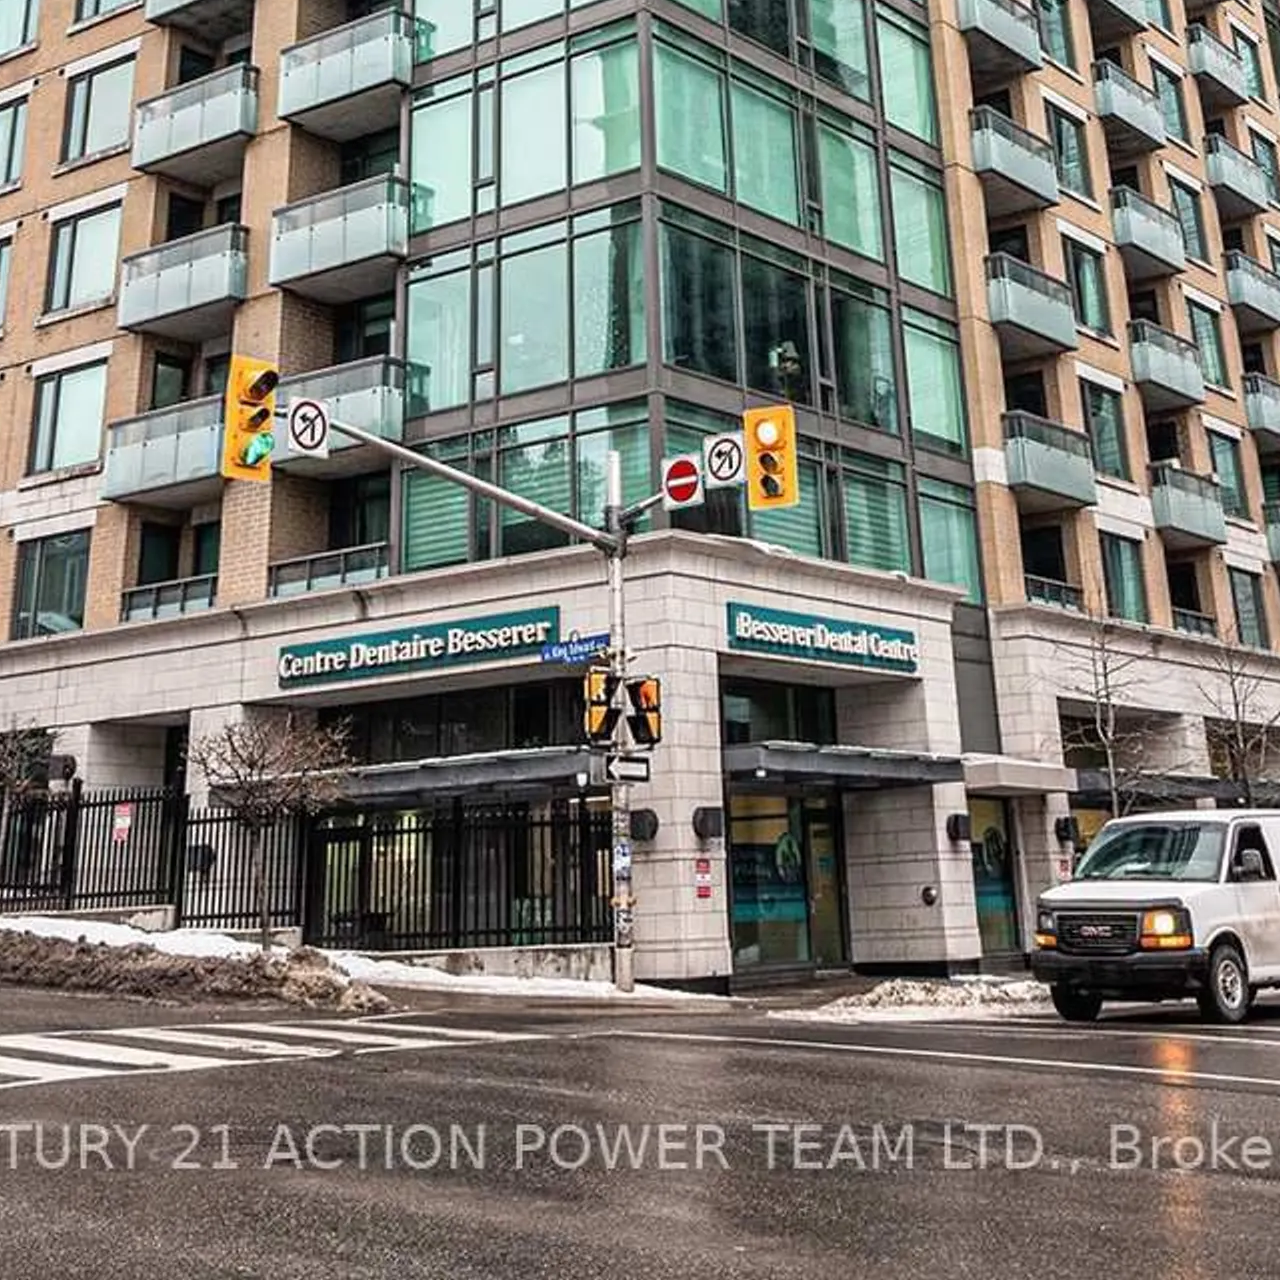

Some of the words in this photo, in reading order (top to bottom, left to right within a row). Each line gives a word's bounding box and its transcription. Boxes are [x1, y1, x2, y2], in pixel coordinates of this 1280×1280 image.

[278, 649, 345, 678] Centre
[349, 633, 445, 670] Dentaire
[447, 620, 551, 654] Besserer
[735, 612, 816, 647] Besserer
[817, 624, 867, 655] Dental
[870, 633, 920, 662] Centre
[1080, 925, 1112, 937] GMC
